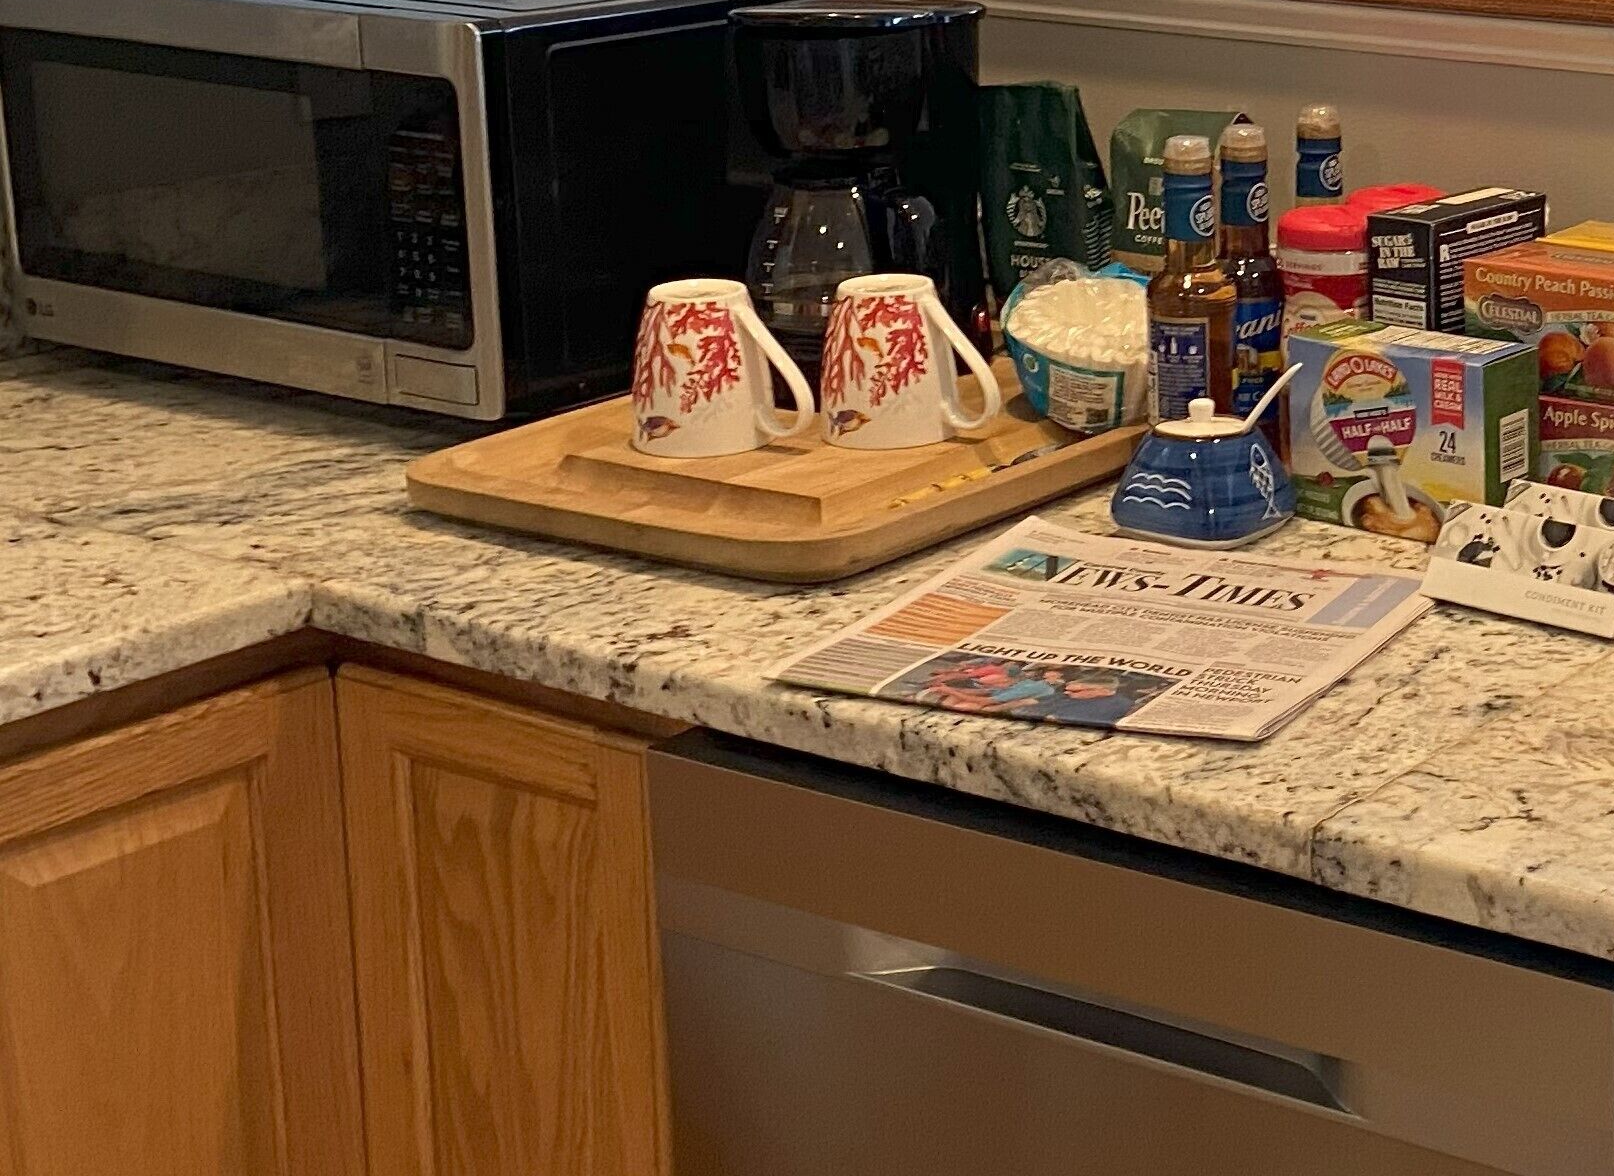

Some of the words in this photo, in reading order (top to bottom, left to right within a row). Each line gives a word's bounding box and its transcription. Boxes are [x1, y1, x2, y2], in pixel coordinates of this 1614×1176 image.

[1475, 267, 1532, 292] Country
[1535, 275, 1576, 295] Peach
[1342, 423, 1372, 440] HALF
[1382, 417, 1413, 434] HALF
[1543, 405, 1588, 428] Apple
[1439, 430, 1457, 454] 24
[956, 642, 1026, 657] LIGHT
[1025, 650, 1058, 661] UP
[1059, 653, 1106, 665] THE
[1108, 657, 1193, 677] WORLD
